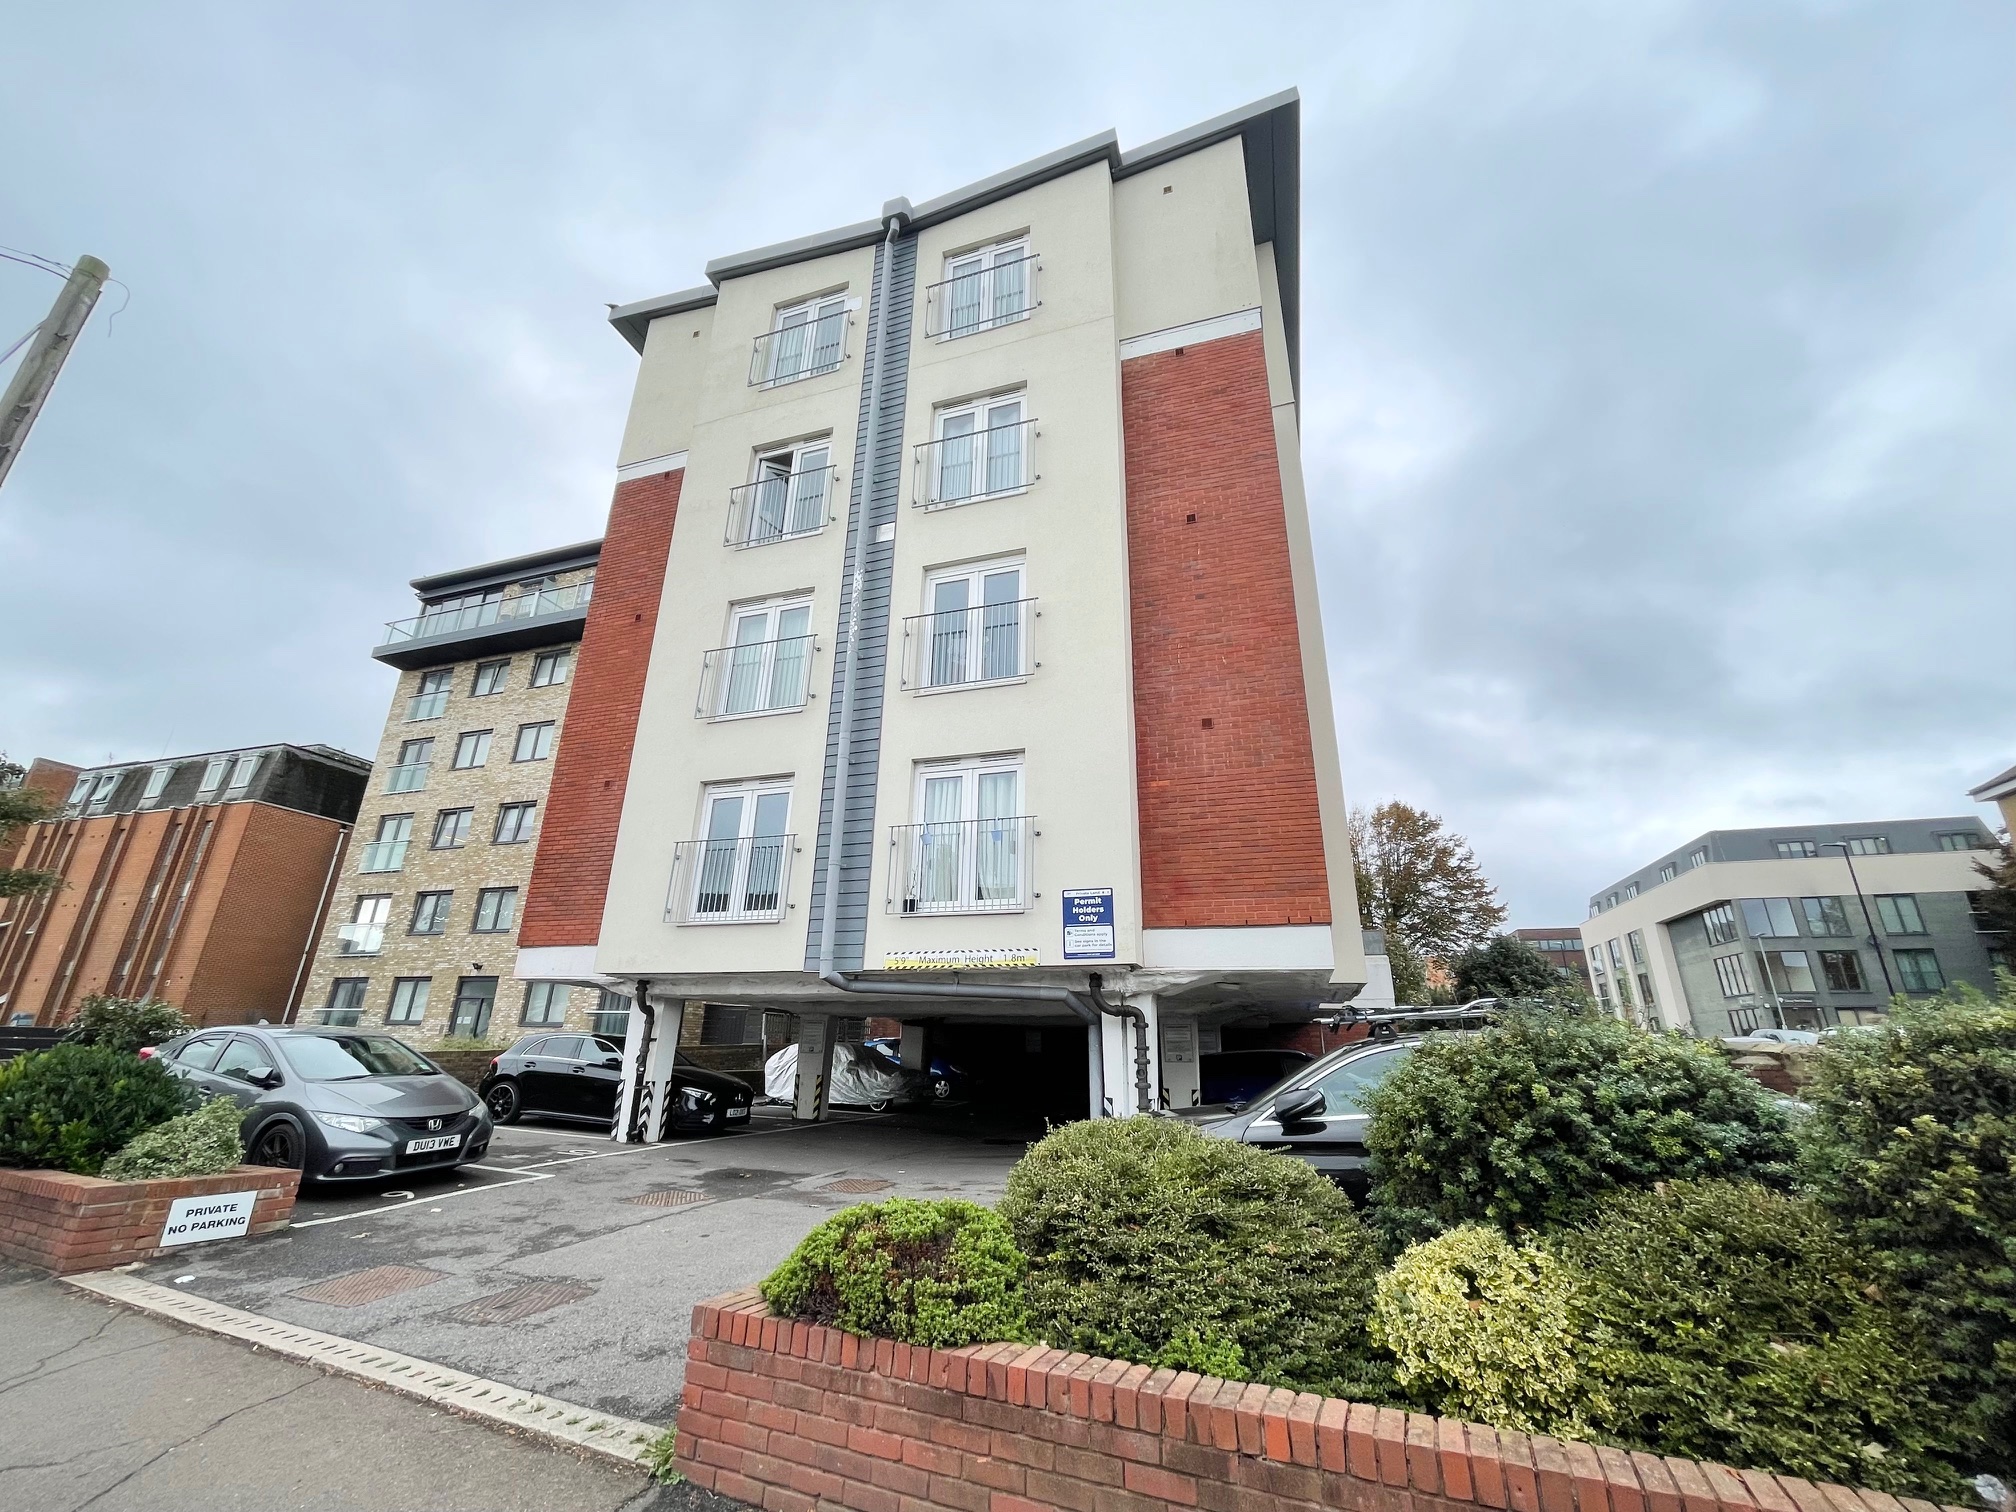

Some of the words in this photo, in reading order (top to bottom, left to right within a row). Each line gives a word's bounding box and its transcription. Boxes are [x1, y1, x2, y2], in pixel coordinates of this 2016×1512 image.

[1074, 896, 1102, 905] Permit
[1072, 906, 1104, 914] Holders
[1078, 914, 1098, 922] Only
[918, 956, 960, 964] Maximum
[964, 955, 993, 964] Height
[413, 1140, 435, 1151] DU13
[185, 1203, 238, 1218] PRIVATE
[168, 1224, 187, 1235] NO
[190, 1216, 246, 1231] PARKING
